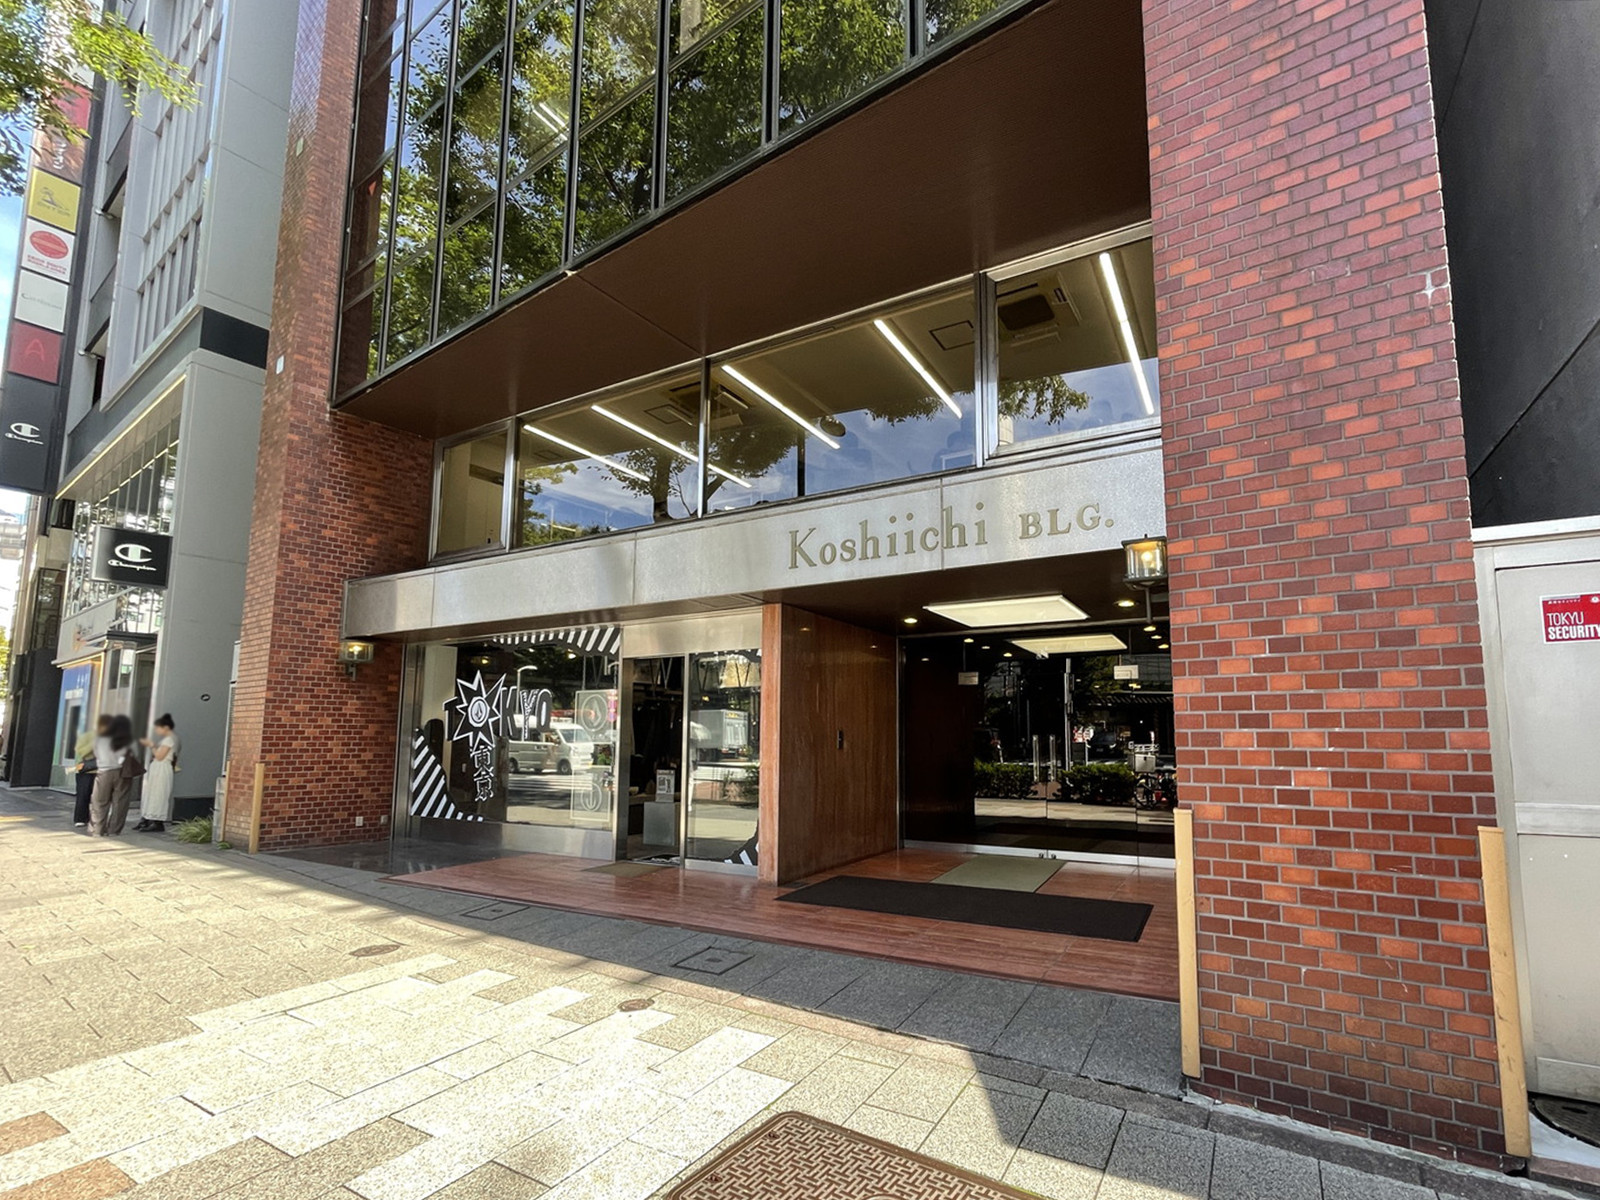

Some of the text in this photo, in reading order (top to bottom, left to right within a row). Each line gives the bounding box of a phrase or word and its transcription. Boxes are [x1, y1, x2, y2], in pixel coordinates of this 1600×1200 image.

[788, 502, 1115, 570] Koshiichi BLG.
[1546, 611, 1585, 626] TOKYU
